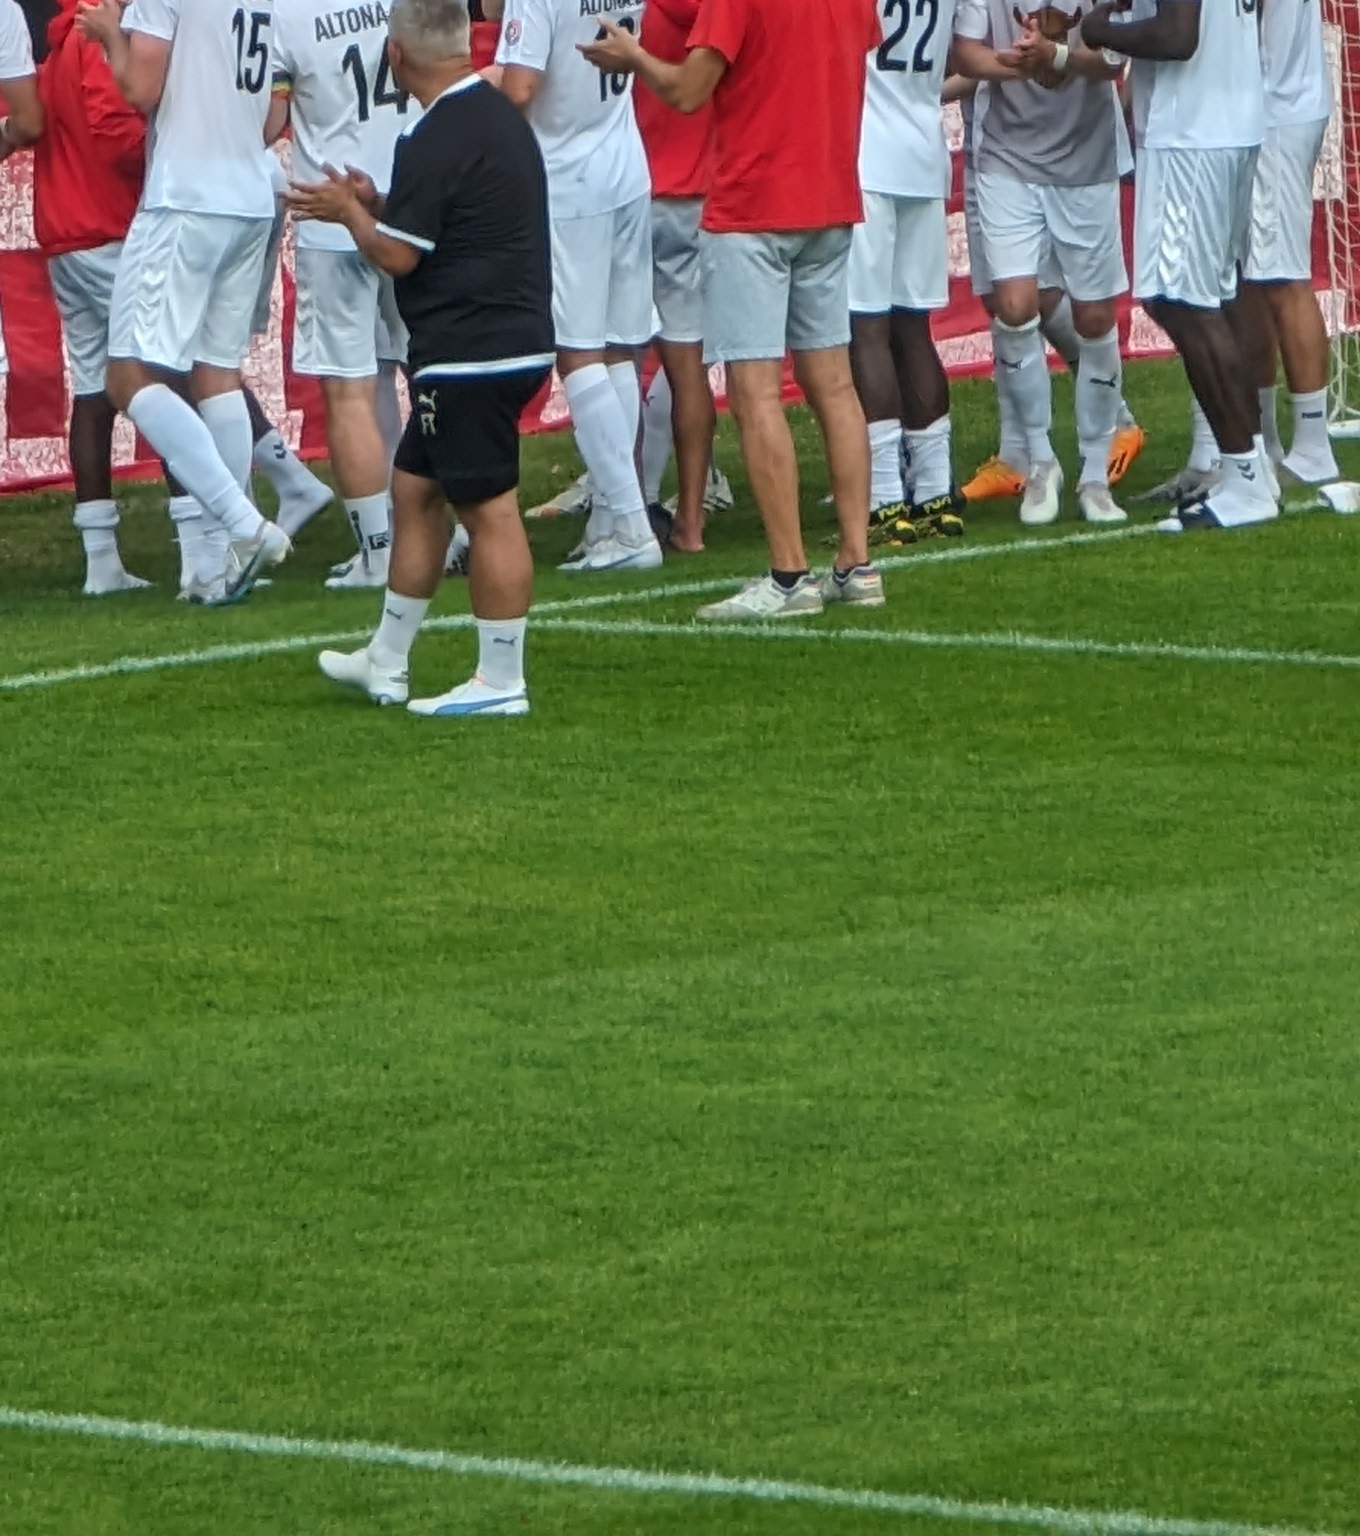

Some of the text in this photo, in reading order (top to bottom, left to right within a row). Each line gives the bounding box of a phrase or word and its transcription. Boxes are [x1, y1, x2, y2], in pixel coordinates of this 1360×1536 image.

[231, 7, 272, 95] 15
[314, 1, 391, 43] ALTONA
[341, 35, 409, 123] 14
